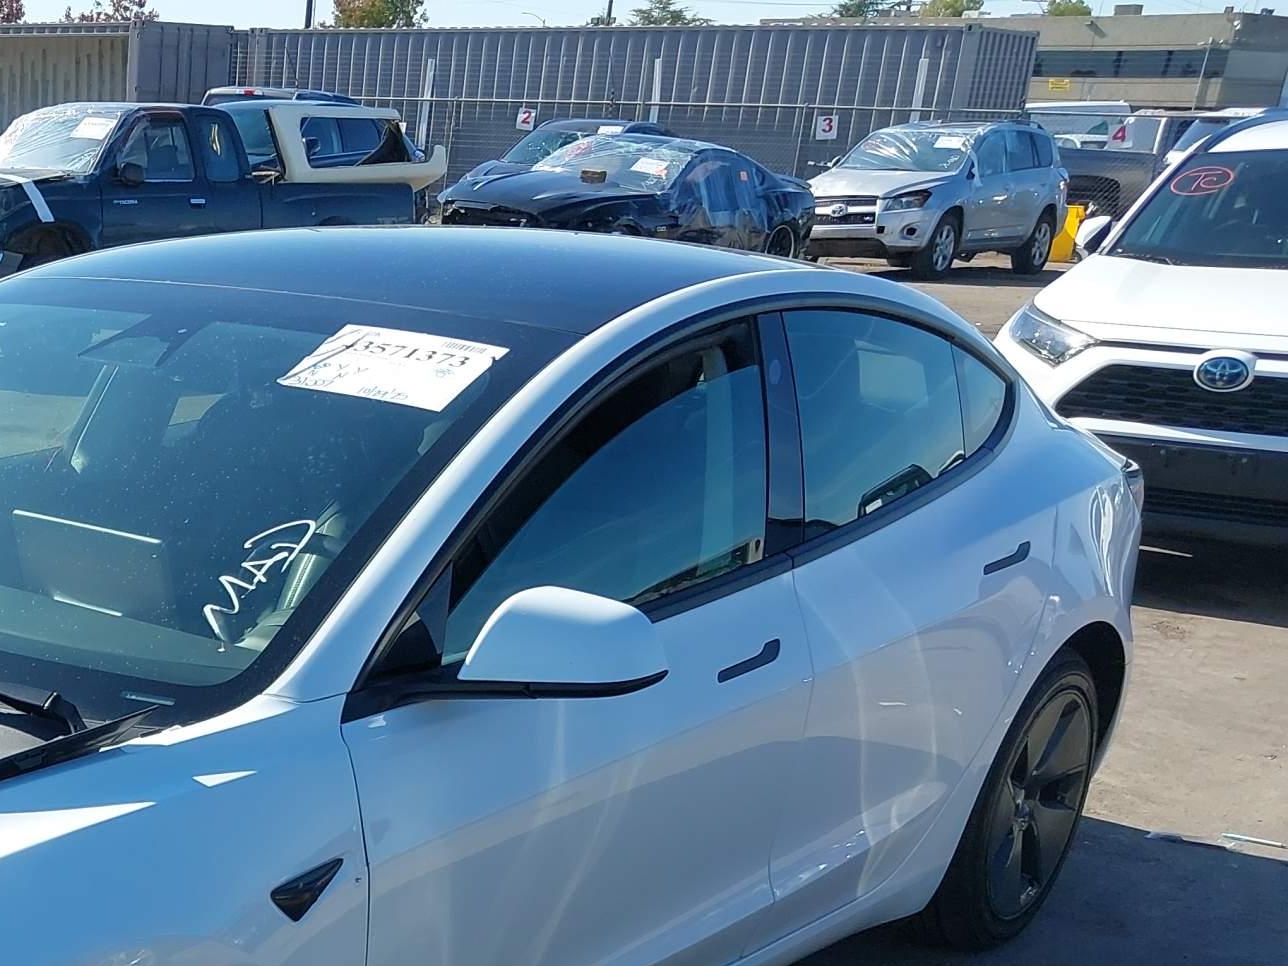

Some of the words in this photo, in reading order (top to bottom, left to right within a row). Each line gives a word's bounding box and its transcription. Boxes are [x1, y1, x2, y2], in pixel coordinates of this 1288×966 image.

[521, 110, 532, 125] 2
[822, 117, 833, 133] 3
[1112, 125, 1127, 142] 4
[203, 519, 316, 652] MAD
